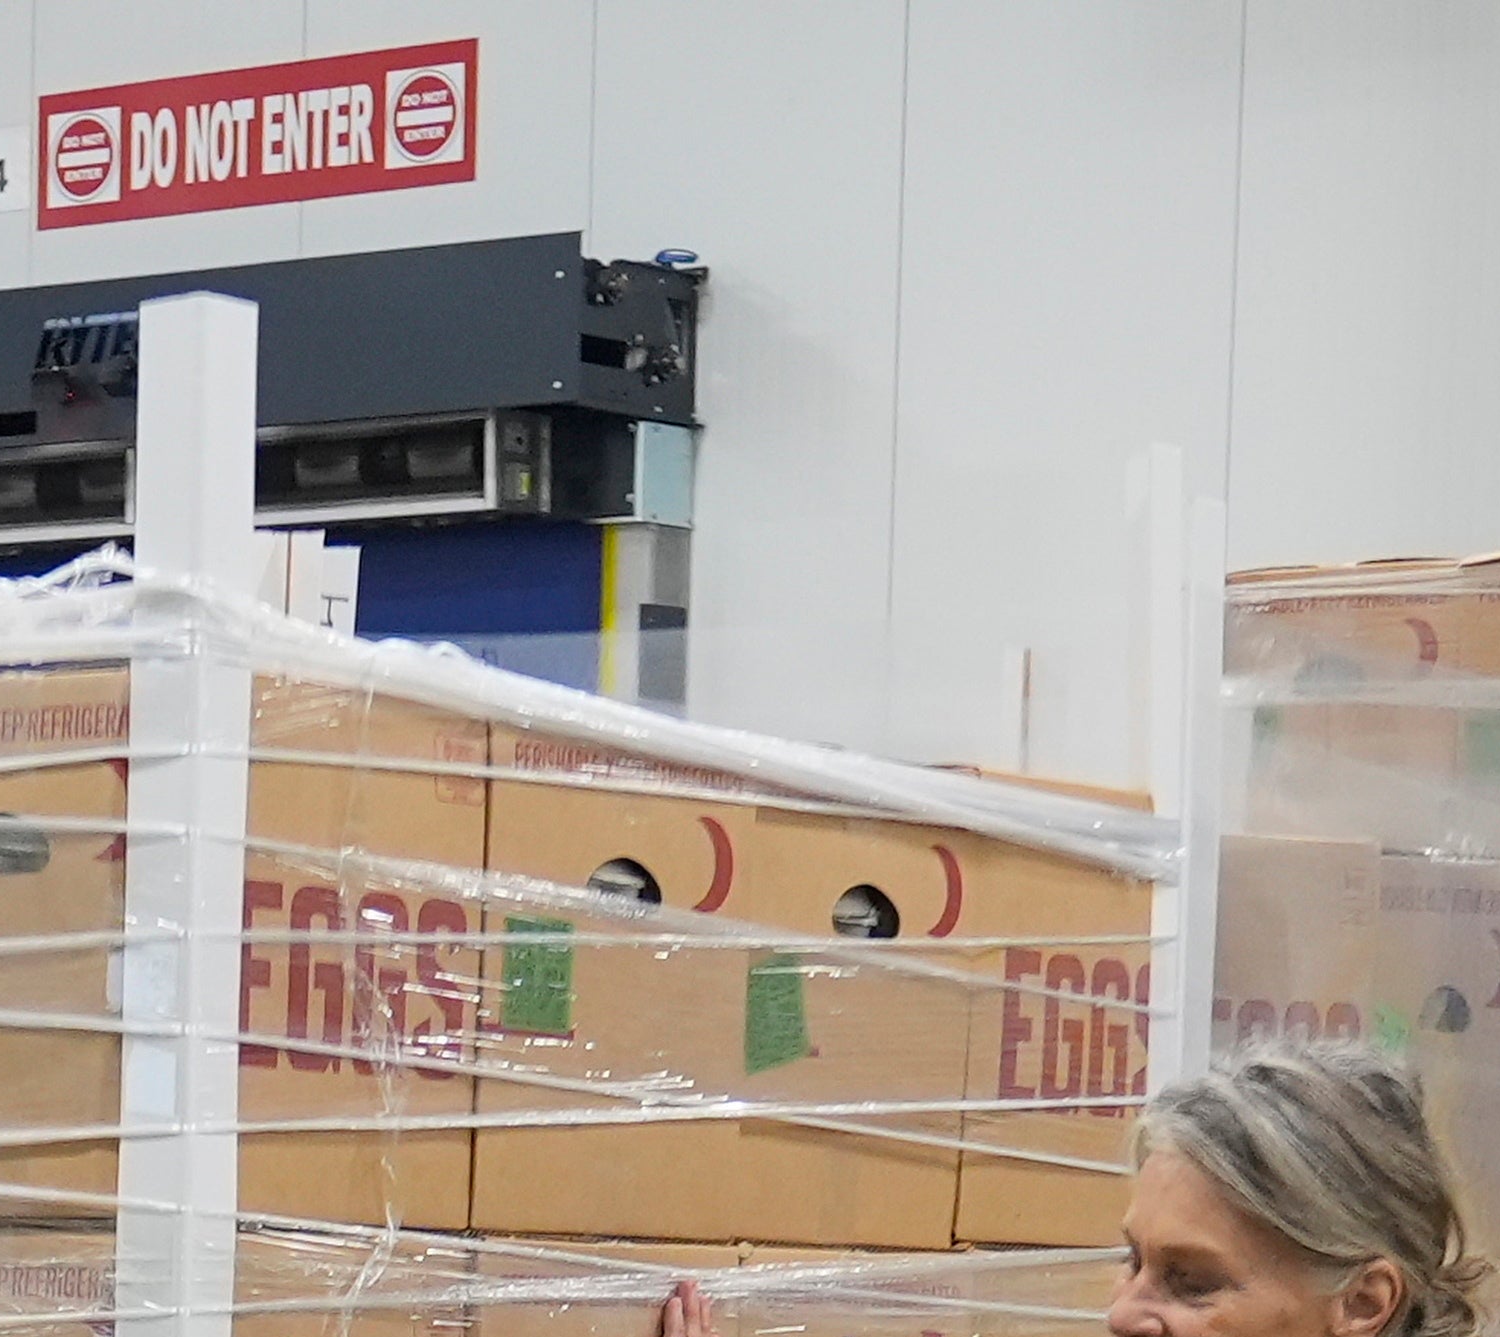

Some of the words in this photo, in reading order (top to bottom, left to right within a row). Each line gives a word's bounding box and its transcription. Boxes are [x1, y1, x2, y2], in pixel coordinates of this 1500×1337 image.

[130, 107, 178, 190] DO
[185, 97, 255, 183] NOT
[261, 83, 375, 175] ENTER
[27, 696, 131, 745] REFRIGERA
[238, 880, 468, 1076] EGGS
